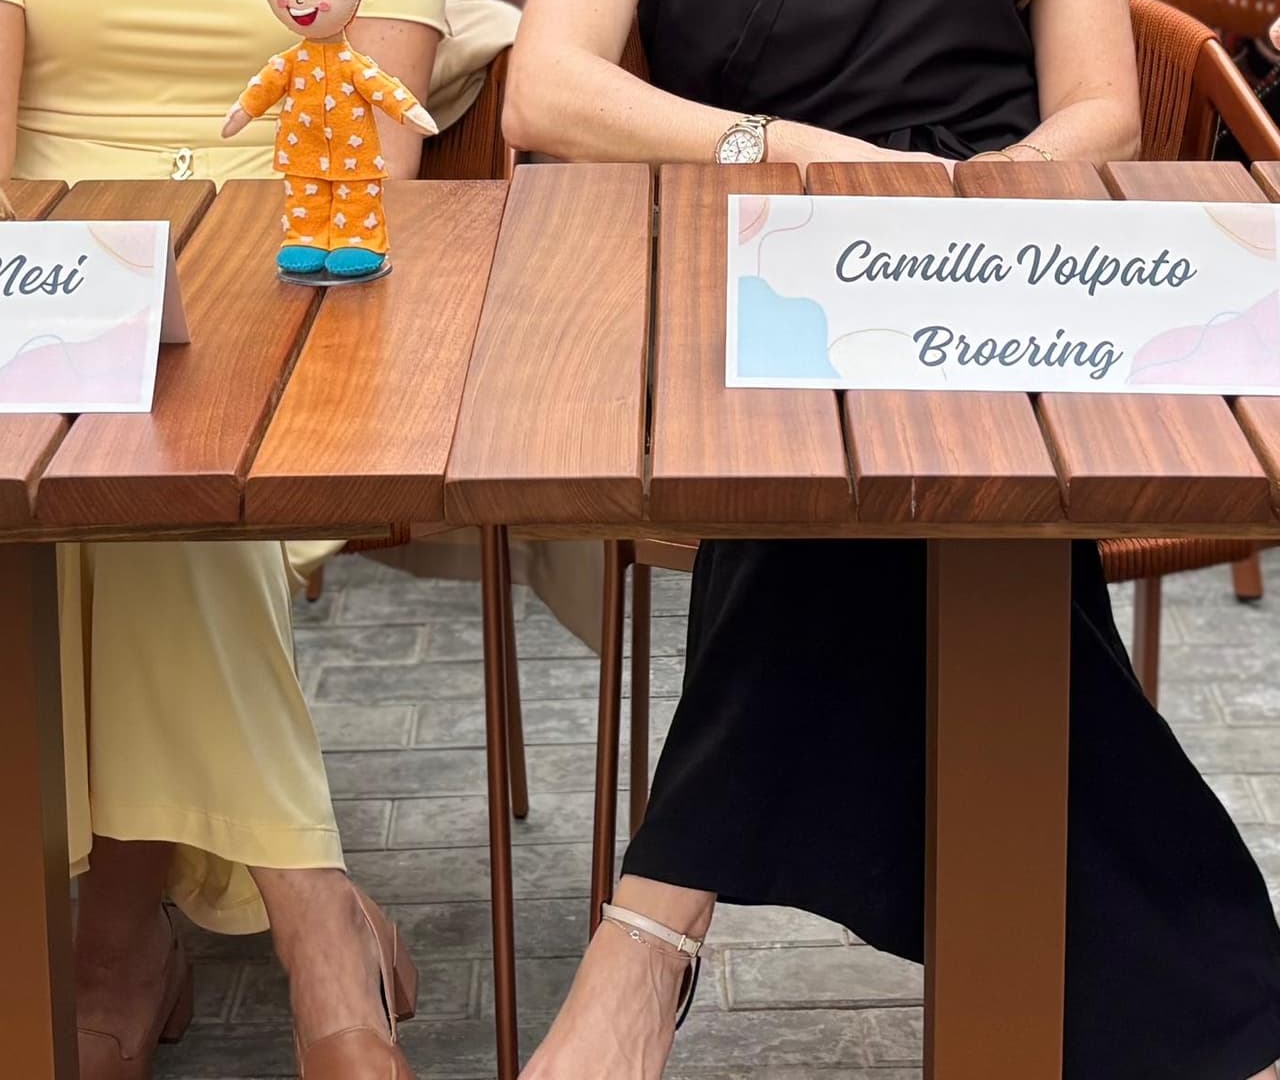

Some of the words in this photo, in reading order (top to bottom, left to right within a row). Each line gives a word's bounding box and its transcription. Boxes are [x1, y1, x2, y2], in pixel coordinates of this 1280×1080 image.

[835, 239, 1013, 284] Camilla
[1016, 243, 1198, 297] Volpato
[912, 325, 1124, 380] Broering
